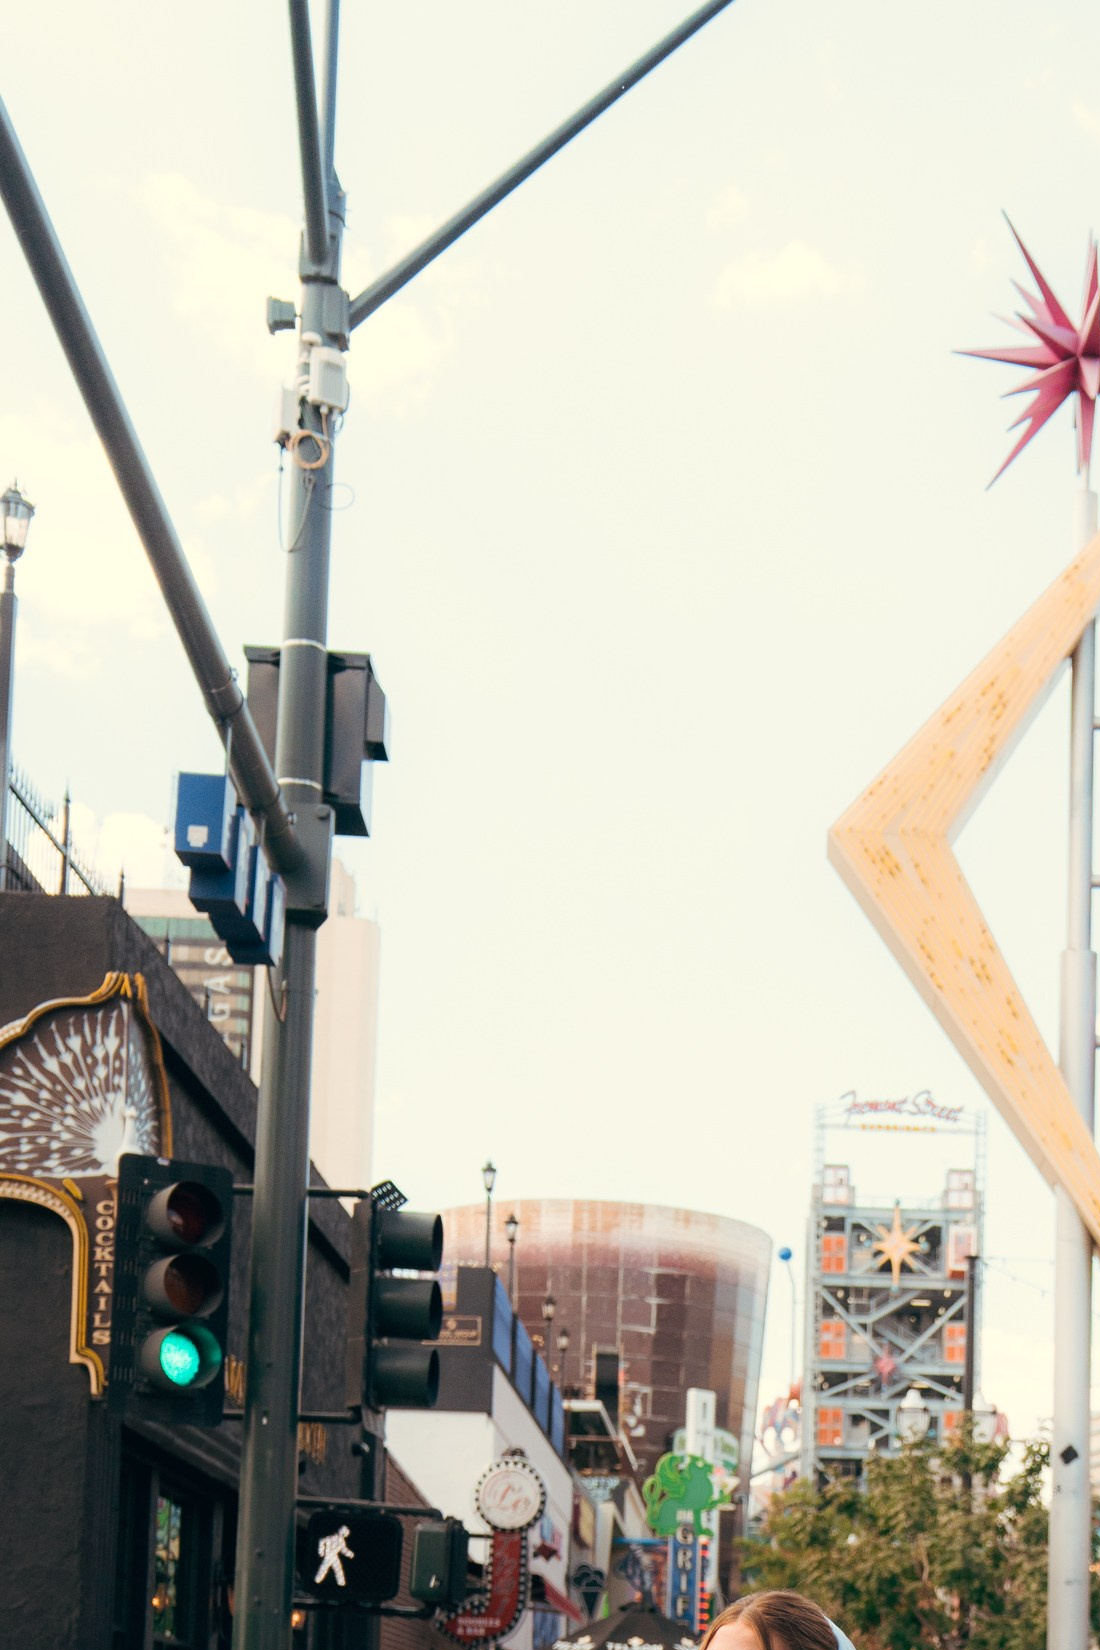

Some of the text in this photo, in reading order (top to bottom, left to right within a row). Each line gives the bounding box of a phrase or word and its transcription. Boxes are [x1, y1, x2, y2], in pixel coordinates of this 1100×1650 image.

[203, 946, 234, 1045] GAS
[92, 1200, 115, 1345] COCKTAILS
[675, 1522, 694, 1625] GRIF
